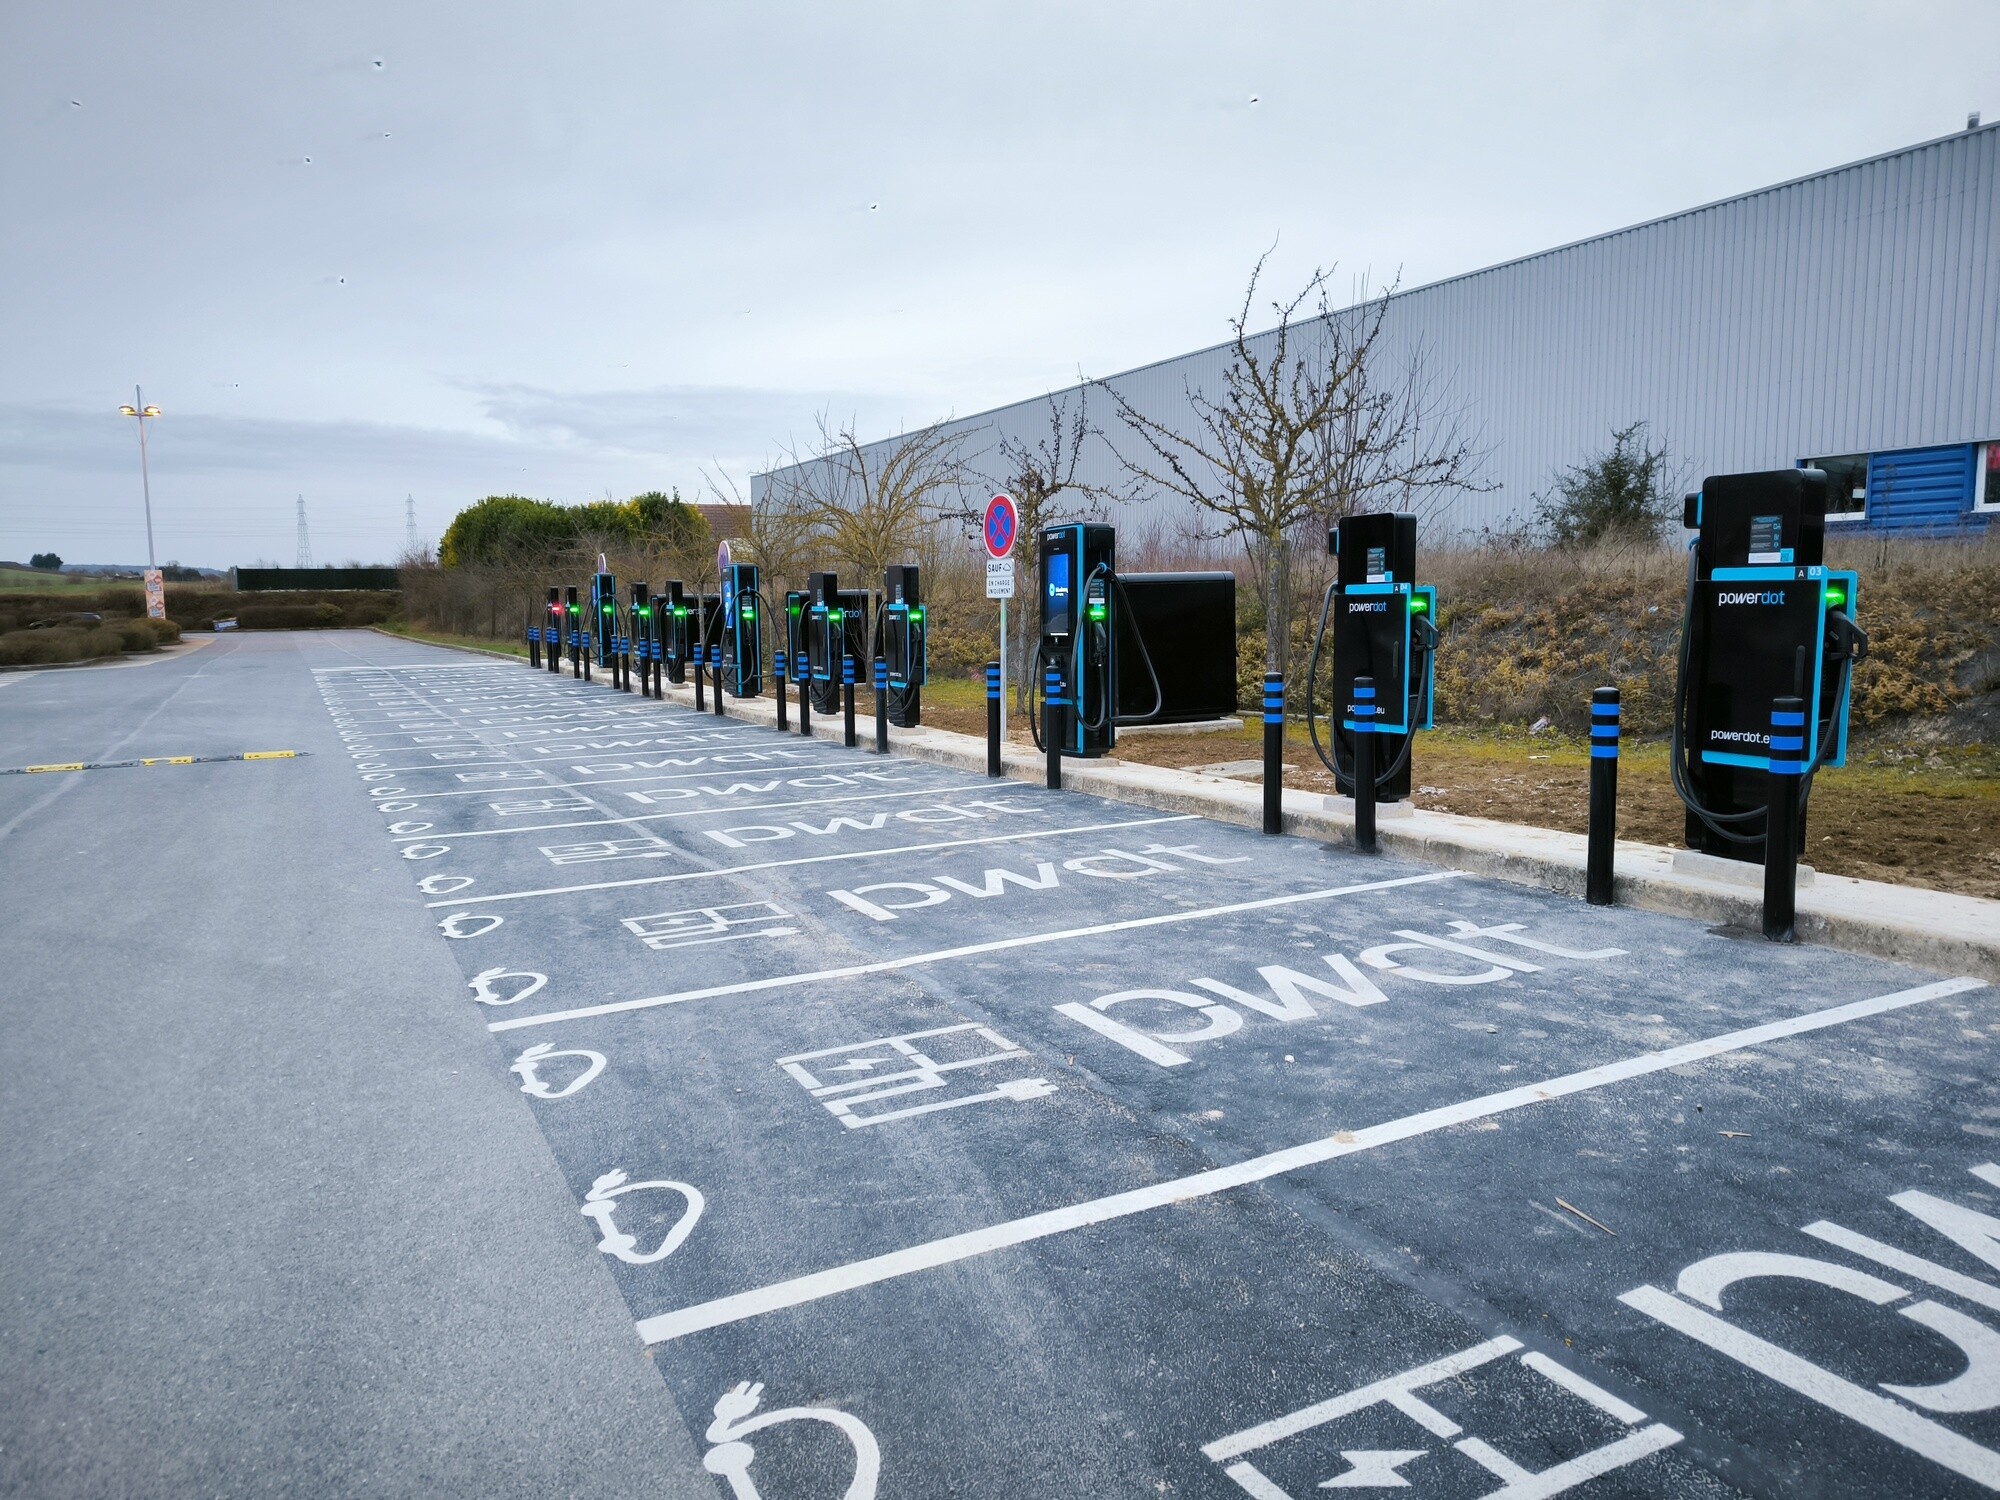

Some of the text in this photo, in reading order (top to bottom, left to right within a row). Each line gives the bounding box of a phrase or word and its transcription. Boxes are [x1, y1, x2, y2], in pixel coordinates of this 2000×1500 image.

[988, 563, 1002, 573] SAUF
[1798, 567, 1822, 578] A 03
[1348, 602, 1387, 614] powerdot
[1718, 590, 1785, 607] powerdot
[1711, 729, 1770, 744] powerdot.e
[571, 749, 817, 775] pwdt
[624, 770, 910, 804] pwdt
[703, 799, 1044, 849] pwdt
[827, 843, 1252, 921] pwdt
[1053, 919, 1629, 1067] pwdt
